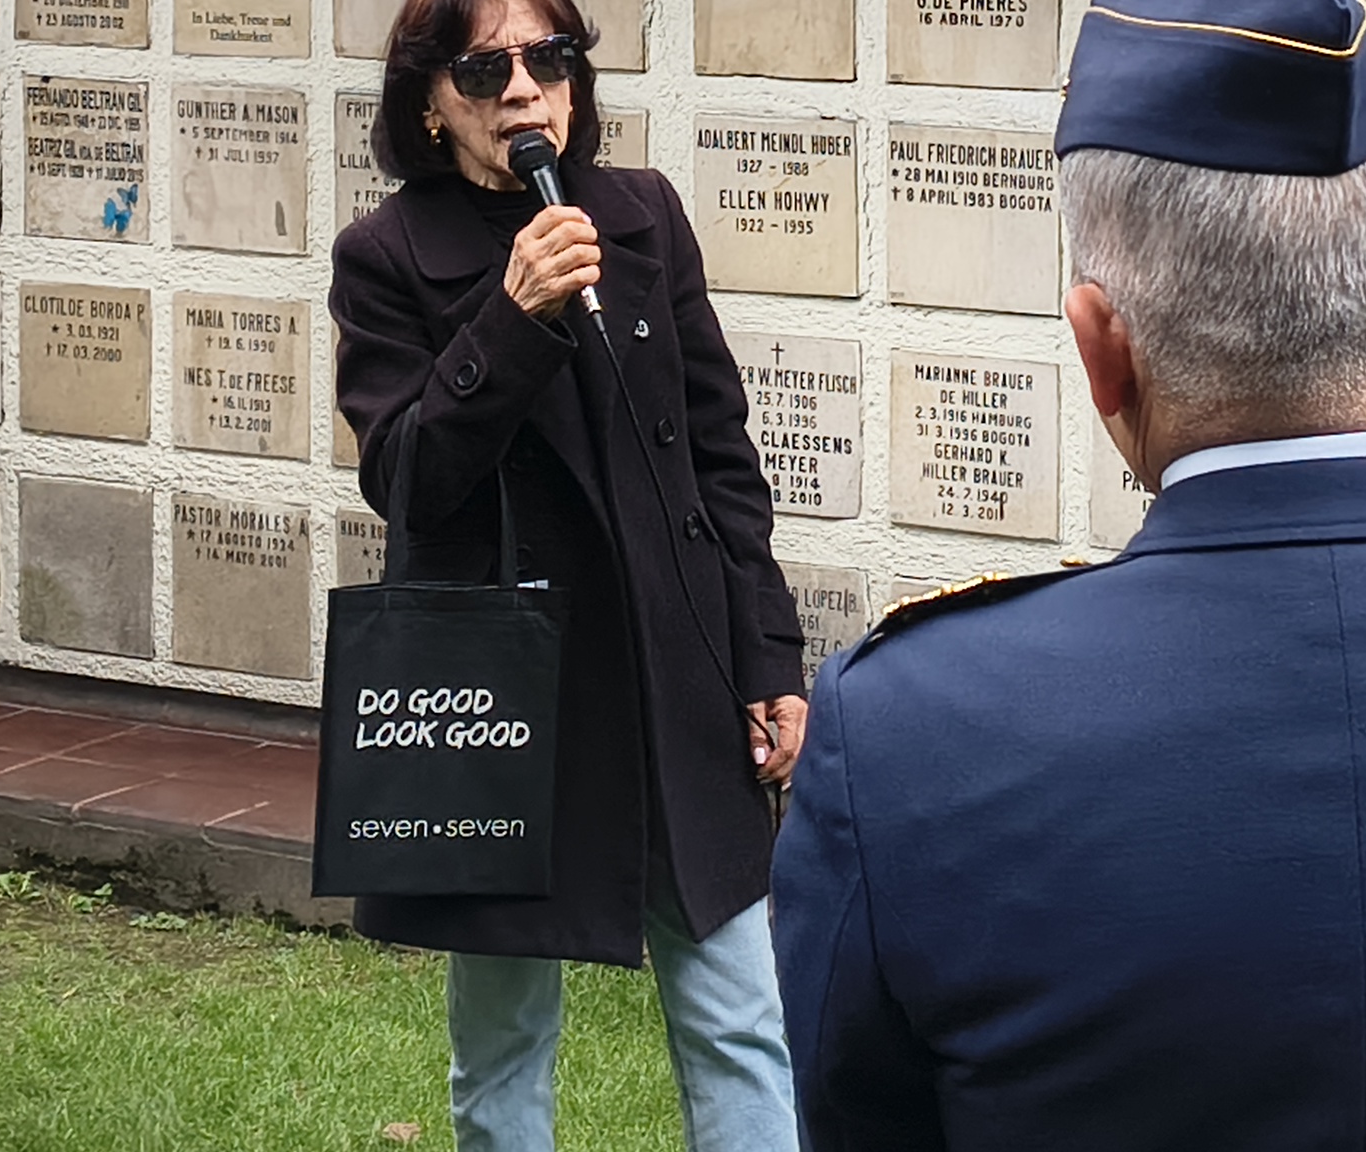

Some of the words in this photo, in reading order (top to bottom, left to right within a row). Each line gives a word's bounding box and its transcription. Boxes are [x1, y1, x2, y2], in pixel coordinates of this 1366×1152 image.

[256, 104, 298, 124] MASON
[890, 140, 924, 163] PAUL
[927, 142, 997, 168] FRIEDRICH
[1000, 147, 1054, 171] BRAUER
[719, 189, 766, 211] ELLEN
[774, 191, 830, 212] HOHWY
[999, 193, 1052, 212] BOGOTA
[90, 300, 131, 320] BORDA
[186, 308, 224, 329] MARIA
[231, 311, 281, 334] TORRES
[246, 372, 296, 395] FREESE
[914, 364, 977, 386] MARIANNE
[983, 370, 1033, 391] BRAUER
[962, 389, 1008, 409] HILLER
[760, 430, 853, 455] CLAESSENS
[934, 442, 993, 465] GERHARD
[764, 452, 818, 474] MEYER
[174, 503, 222, 527] PASTOR
[229, 510, 292, 535] MORALES
[357, 688, 400, 715] DO
[407, 687, 494, 717] GOOD
[356, 720, 439, 750] LOOK
[445, 721, 531, 750] GOOD
